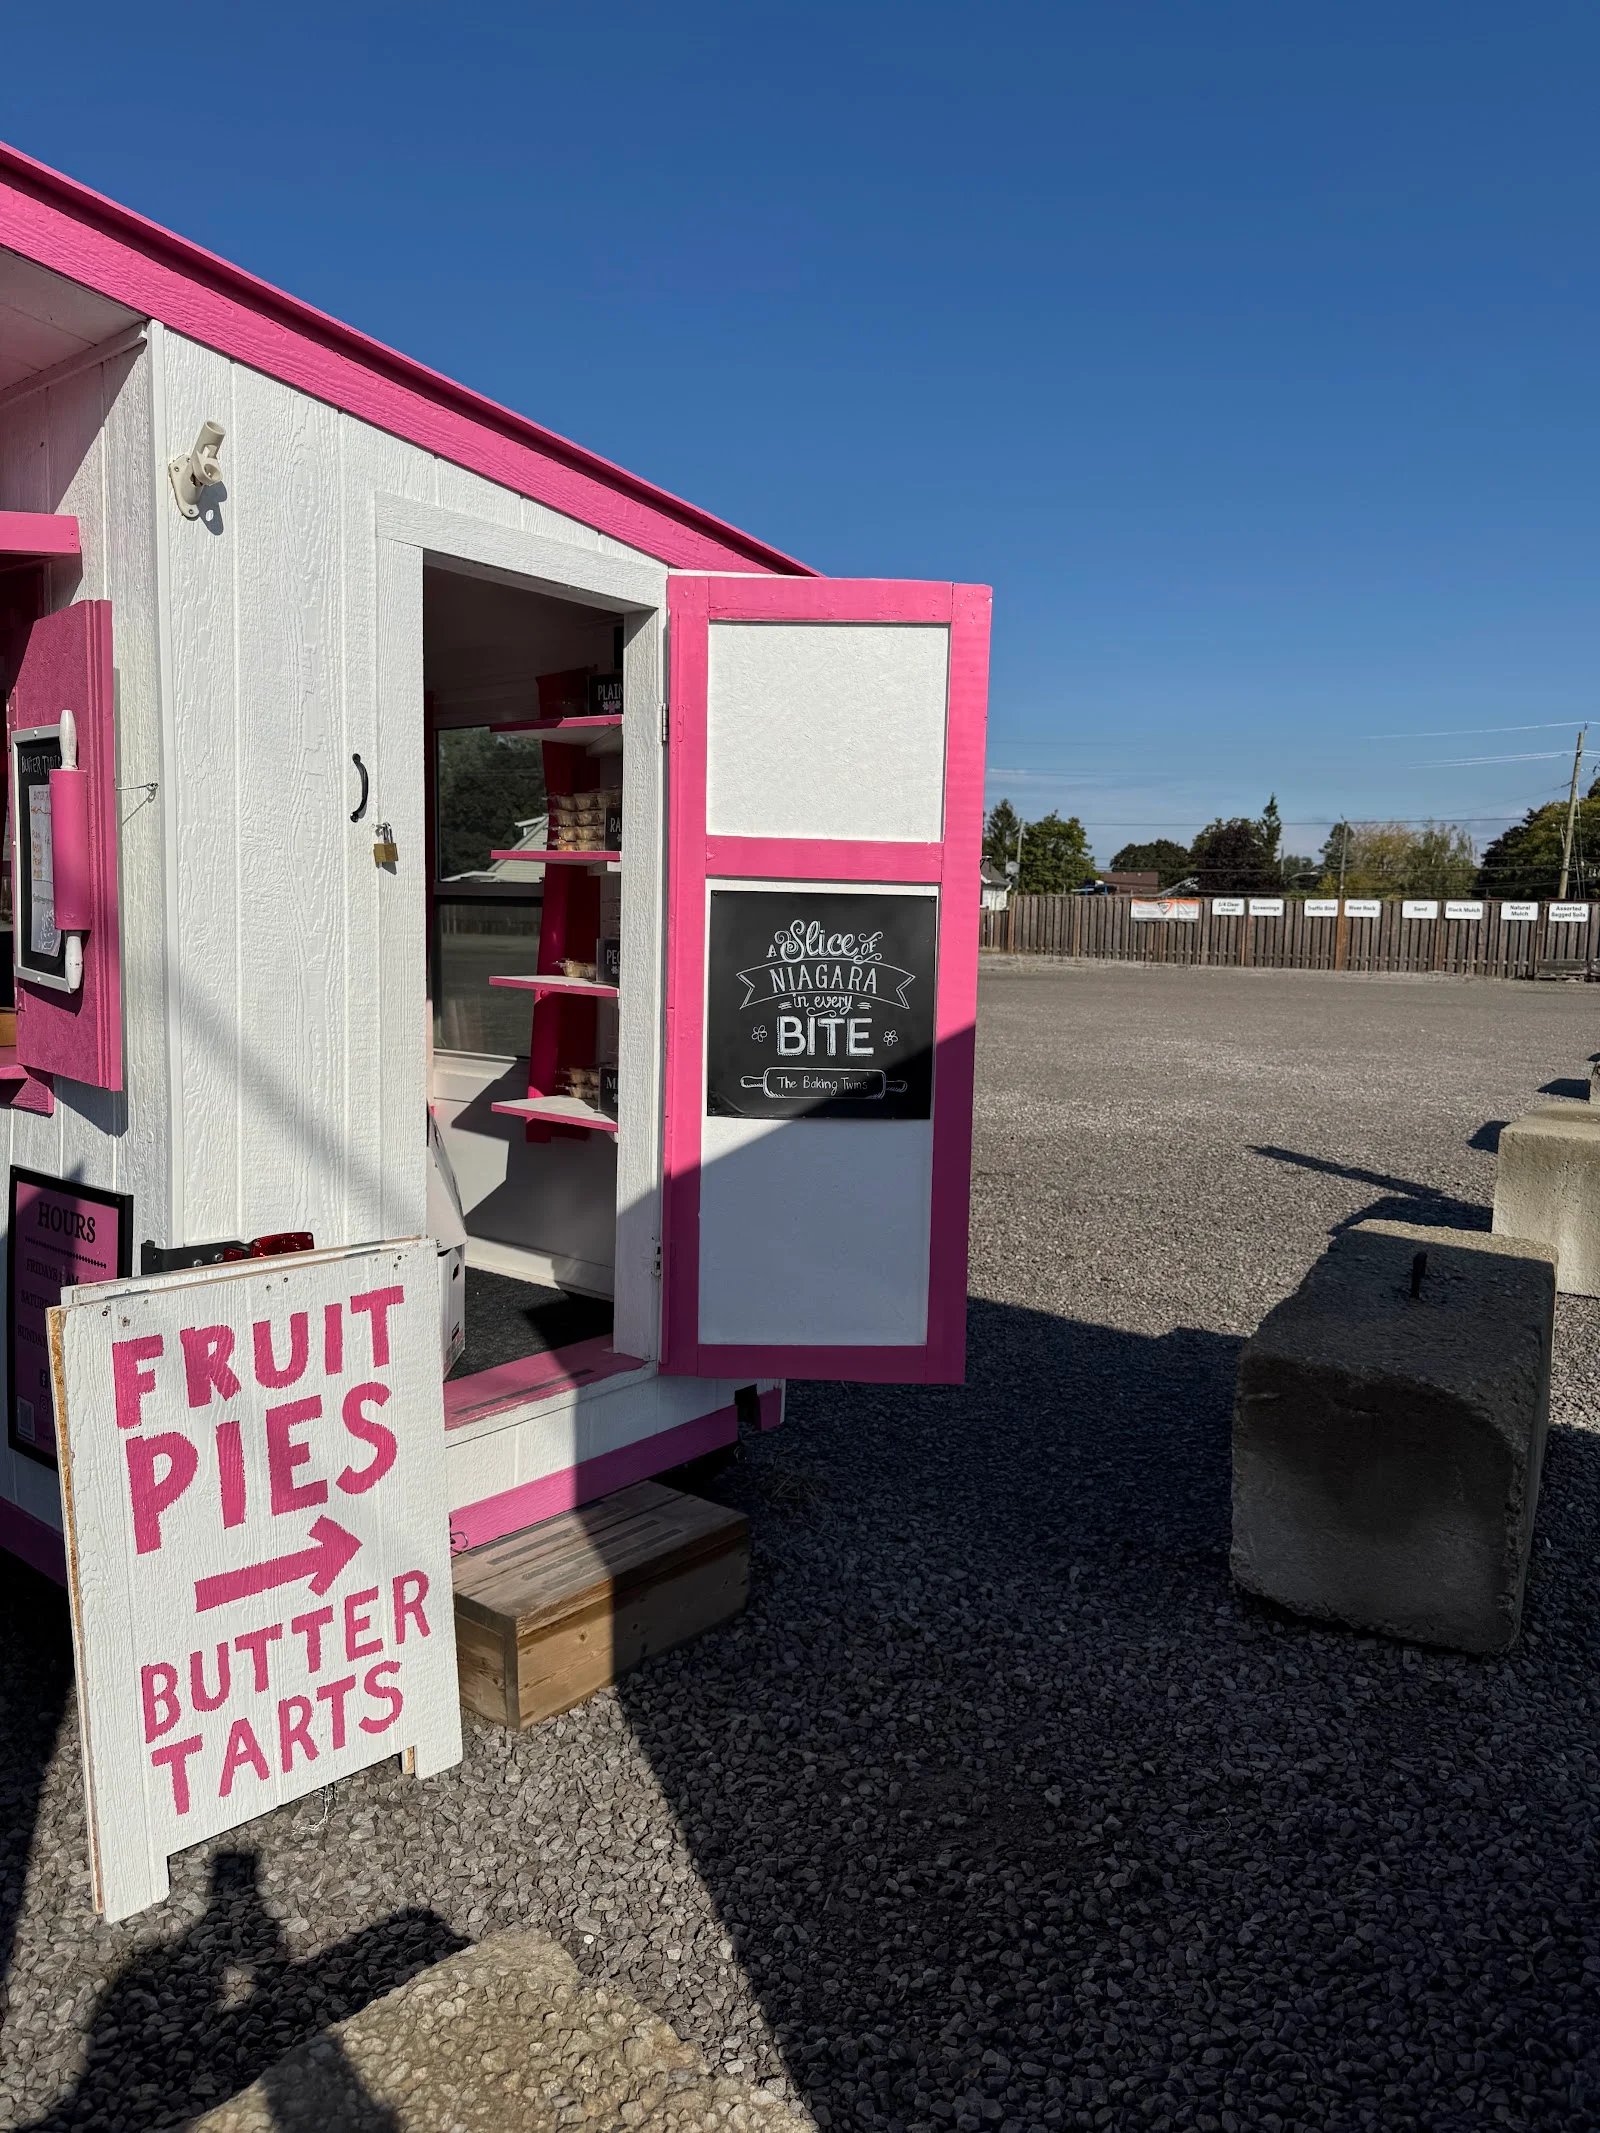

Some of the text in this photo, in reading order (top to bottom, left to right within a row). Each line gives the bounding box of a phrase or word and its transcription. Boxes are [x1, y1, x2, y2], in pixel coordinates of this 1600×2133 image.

[766, 945, 778, 958] A
[775, 919, 858, 963] Slice
[769, 964, 877, 994] NIAGARA
[792, 994, 853, 1015] in every
[777, 1015, 874, 1056] BITE
[777, 1076, 798, 1089] The
[803, 1076, 838, 1096] Baking
[37, 1201, 96, 1244] HOURS
[27, 1258, 58, 1282] FRIDAYS
[112, 1284, 404, 1431] FRUIT
[126, 1382, 398, 1555] PIES
[141, 1569, 432, 1744] BUTTER
[151, 1661, 404, 1817] TARTS
